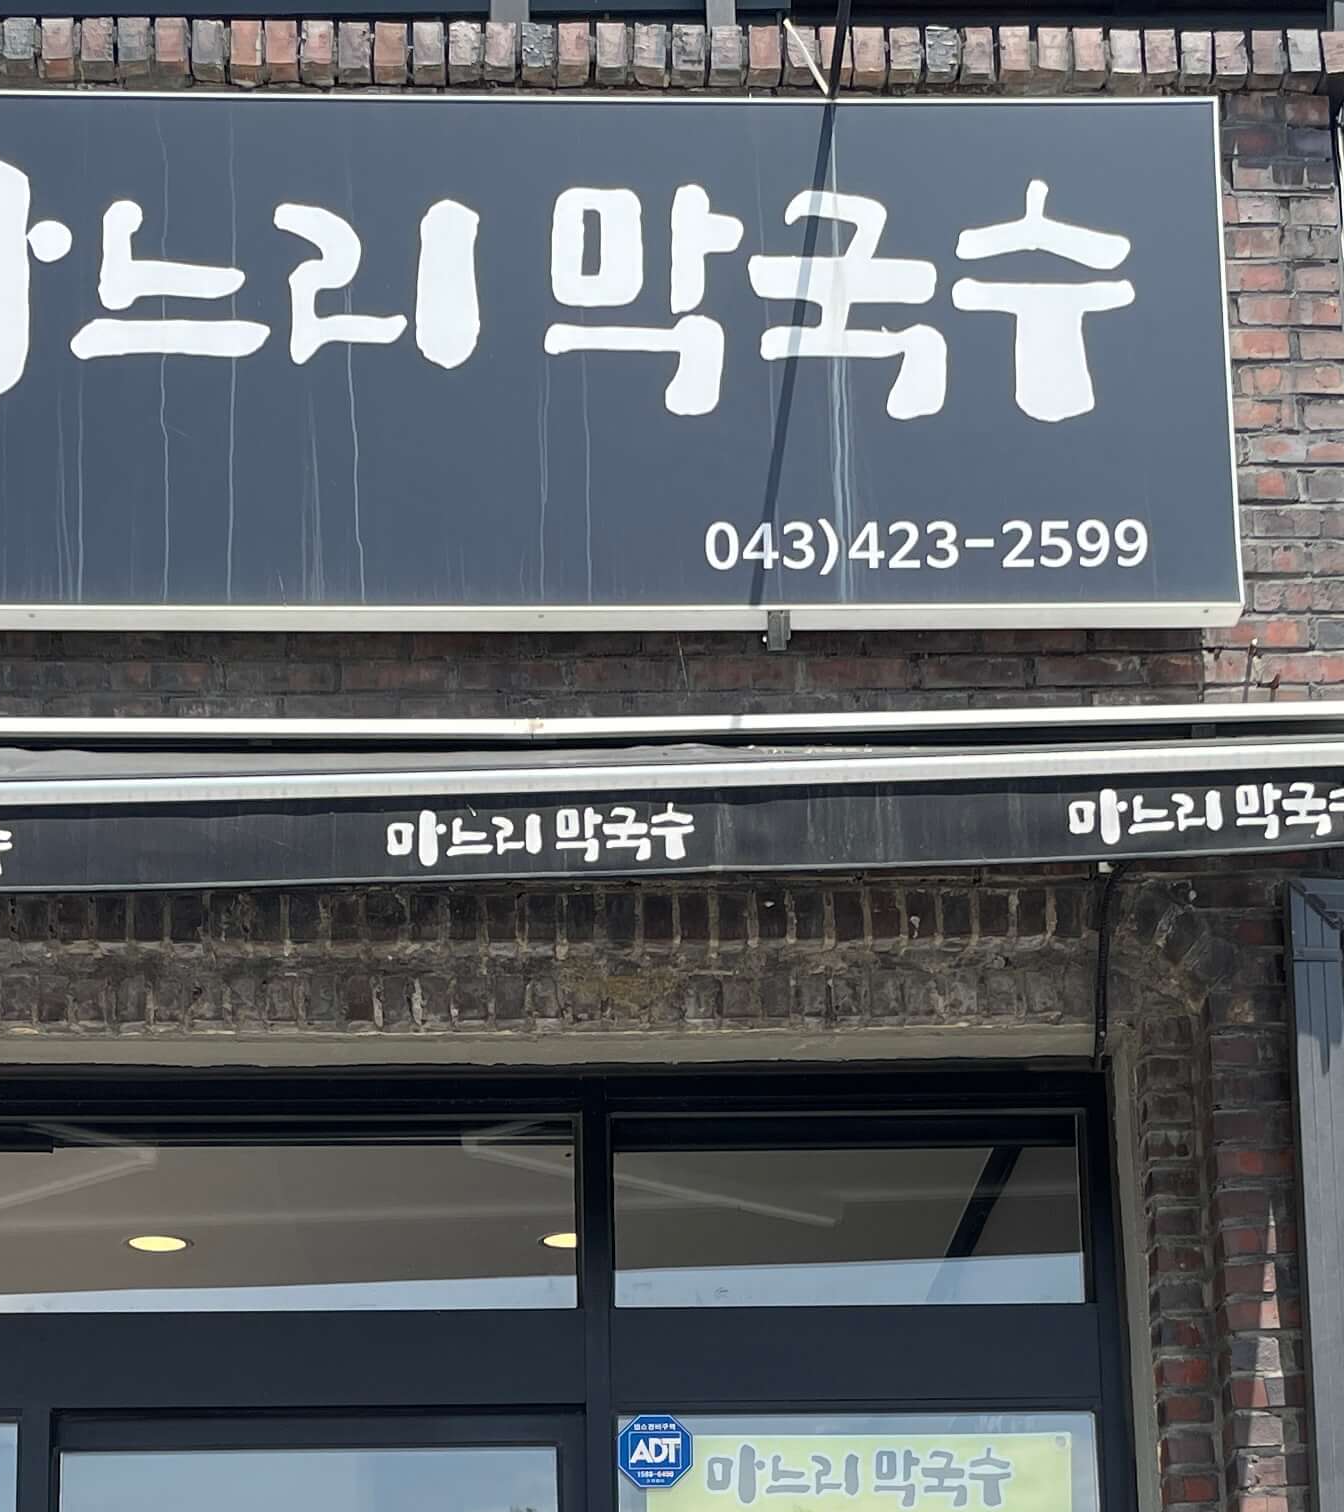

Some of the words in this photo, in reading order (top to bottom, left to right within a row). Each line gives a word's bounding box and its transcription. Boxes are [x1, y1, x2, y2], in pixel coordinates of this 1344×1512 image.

[544, 178, 1137, 422] 막국수
[704, 516, 1150, 576] 043)423-2599
[387, 808, 541, 866] 마느리
[554, 801, 695, 863] 막국수
[1068, 788, 1223, 844] 마느리
[629, 1437, 681, 1464] ADT
[706, 1443, 861, 1504] 마느리
[873, 1447, 1013, 1508] 막국수
